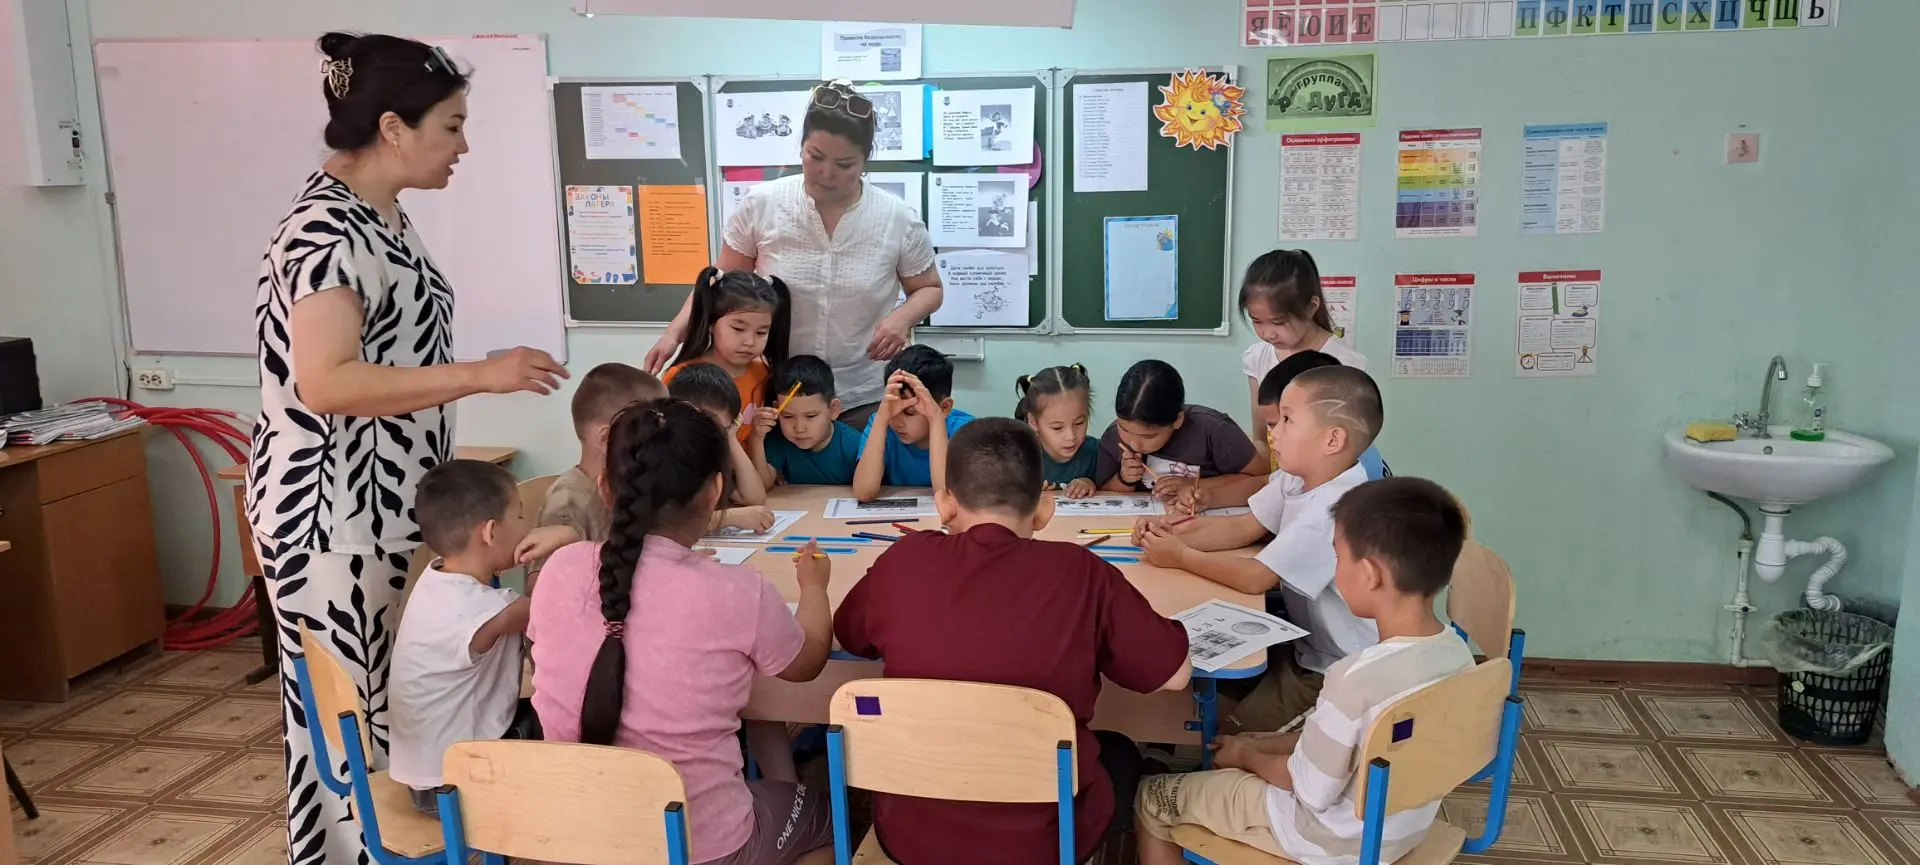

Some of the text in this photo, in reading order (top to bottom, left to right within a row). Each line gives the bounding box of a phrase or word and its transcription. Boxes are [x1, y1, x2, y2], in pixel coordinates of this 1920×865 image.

[1299, 15, 1321, 36] Ю
[1327, 15, 1345, 35] И
[1357, 14, 1371, 34] Е
[1519, 7, 1536, 28] П
[1545, 6, 1566, 27] Ф
[1576, 5, 1593, 27] К
[1605, 4, 1621, 25] Т
[1628, 4, 1653, 25] Ш
[1662, 2, 1677, 24] С
[1688, 1, 1708, 23] Х
[1715, 0, 1737, 28] Ц
[1750, 0, 1766, 21] Ч
[1773, 0, 1798, 27] Щ
[1296, 74, 1342, 91] группа
[777, 820, 793, 849] ONE
[790, 795, 804, 822] NICE
